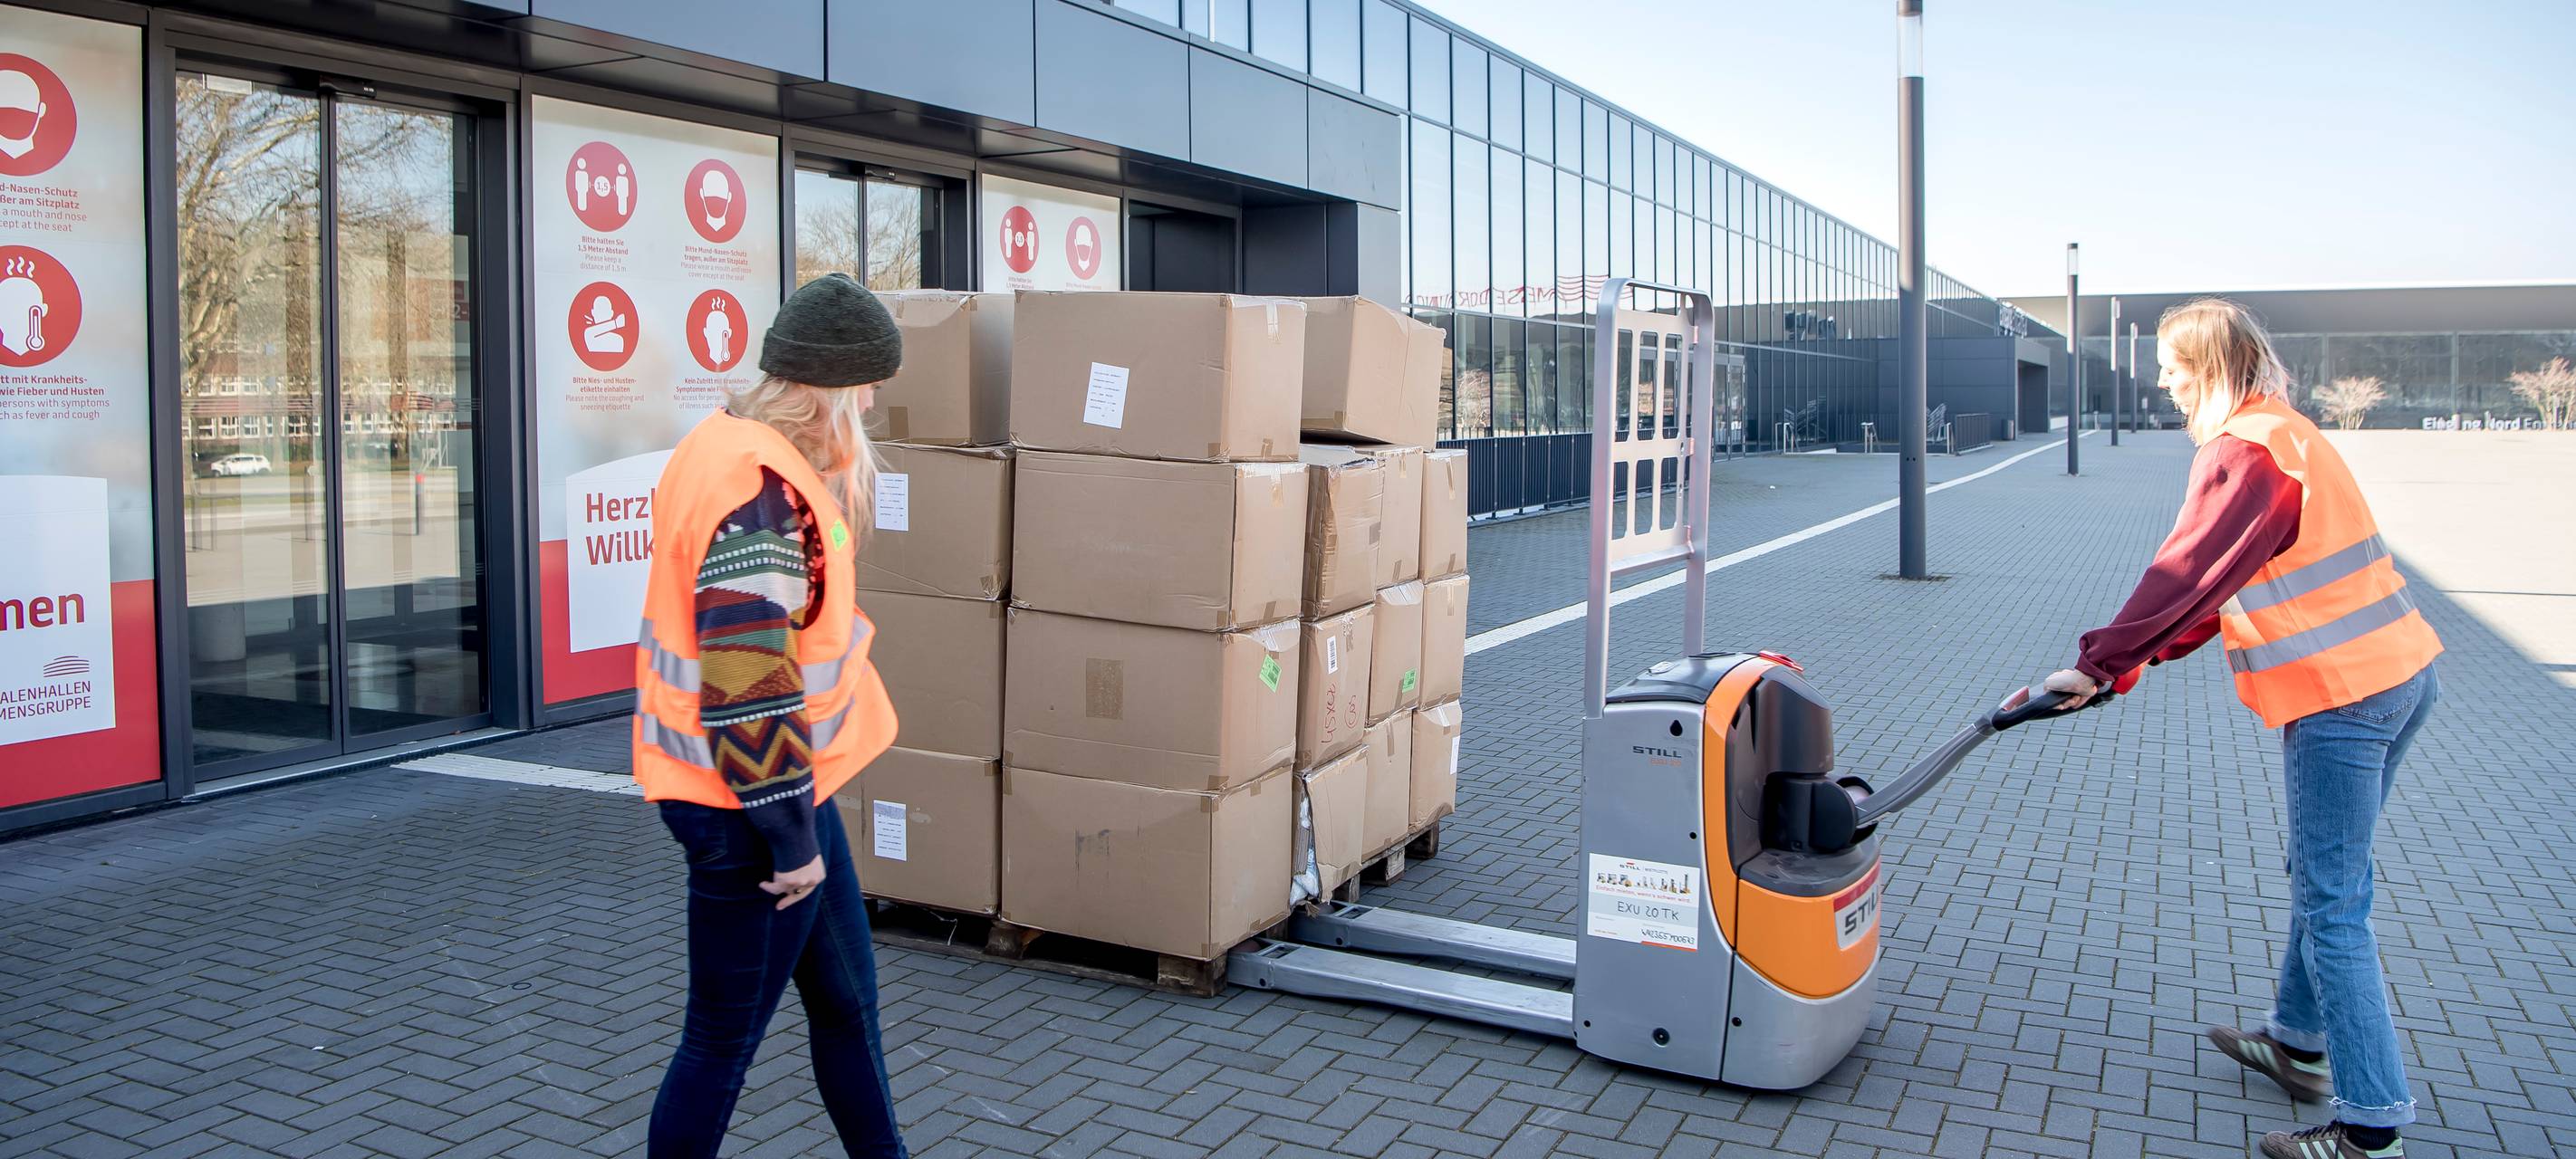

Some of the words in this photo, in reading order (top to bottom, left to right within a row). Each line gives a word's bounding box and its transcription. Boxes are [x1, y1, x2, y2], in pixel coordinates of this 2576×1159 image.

[19, 197, 34, 206] am
[36, 197, 80, 209] Sitzplatz
[11, 209, 43, 217] mouth
[45, 211, 62, 219] and
[65, 213, 87, 222] nose
[22, 221, 32, 229] at
[34, 221, 50, 230] the
[52, 223, 72, 232] seat
[582, 235, 596, 244] Bitte
[597, 237, 615, 245] halten
[589, 245, 605, 254] Meter
[606, 247, 629, 255] Abstand
[12, 375, 28, 384] mit
[32, 375, 87, 384] Krankheits-
[17, 388, 48, 396] Fieber
[51, 388, 69, 396] und
[71, 388, 104, 396] Husten
[37, 398, 59, 407] with
[62, 399, 110, 409] symptoms
[25, 411, 50, 419] fever
[53, 410, 70, 419] and
[72, 410, 100, 421] cough
[586, 530, 655, 566] Willk
[0, 680, 91, 704] ALENHALLEN
[1633, 746, 1682, 759] STILL
[1617, 901, 1640, 915] EXU
[1646, 905, 1659, 918] 20
